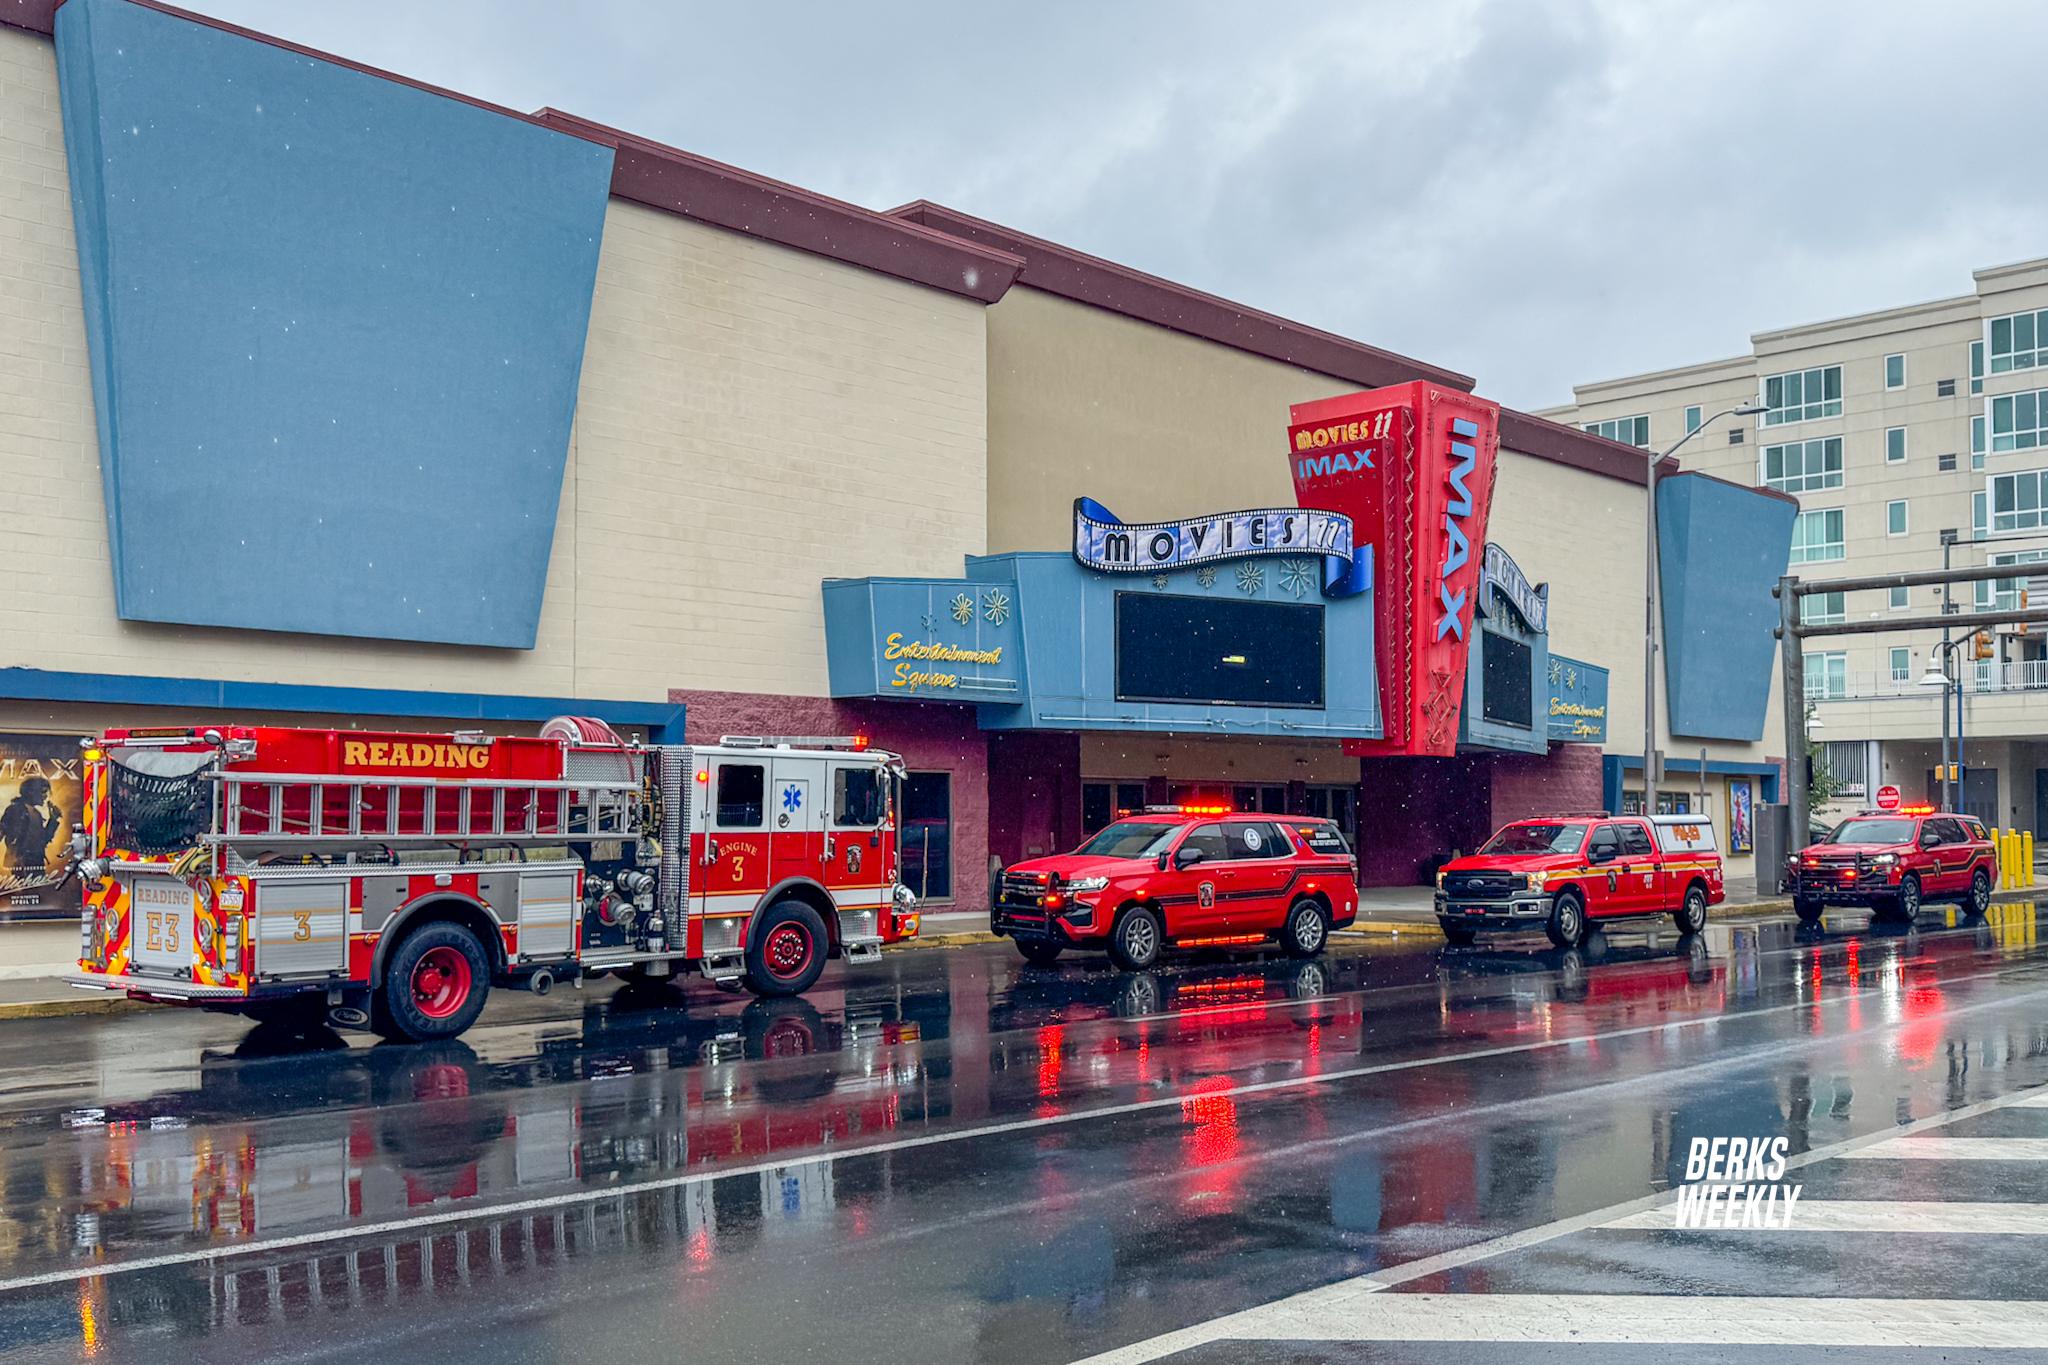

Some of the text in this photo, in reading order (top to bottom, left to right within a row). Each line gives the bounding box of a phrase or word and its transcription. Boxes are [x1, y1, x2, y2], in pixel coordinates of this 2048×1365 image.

[1295, 410, 1393, 451] MOVIES 11
[1298, 448, 1376, 479] IMAX
[1103, 516, 1342, 564] MOVIES 11
[1432, 416, 1479, 643] IMAX
[884, 632, 1003, 665] Entertainment
[891, 663, 958, 694] Square
[344, 741, 490, 769] READING
[719, 841, 758, 856] ENGINE
[731, 856, 744, 882] 3
[137, 888, 189, 905] READING
[146, 911, 180, 952] E3
[293, 910, 312, 942] 3
